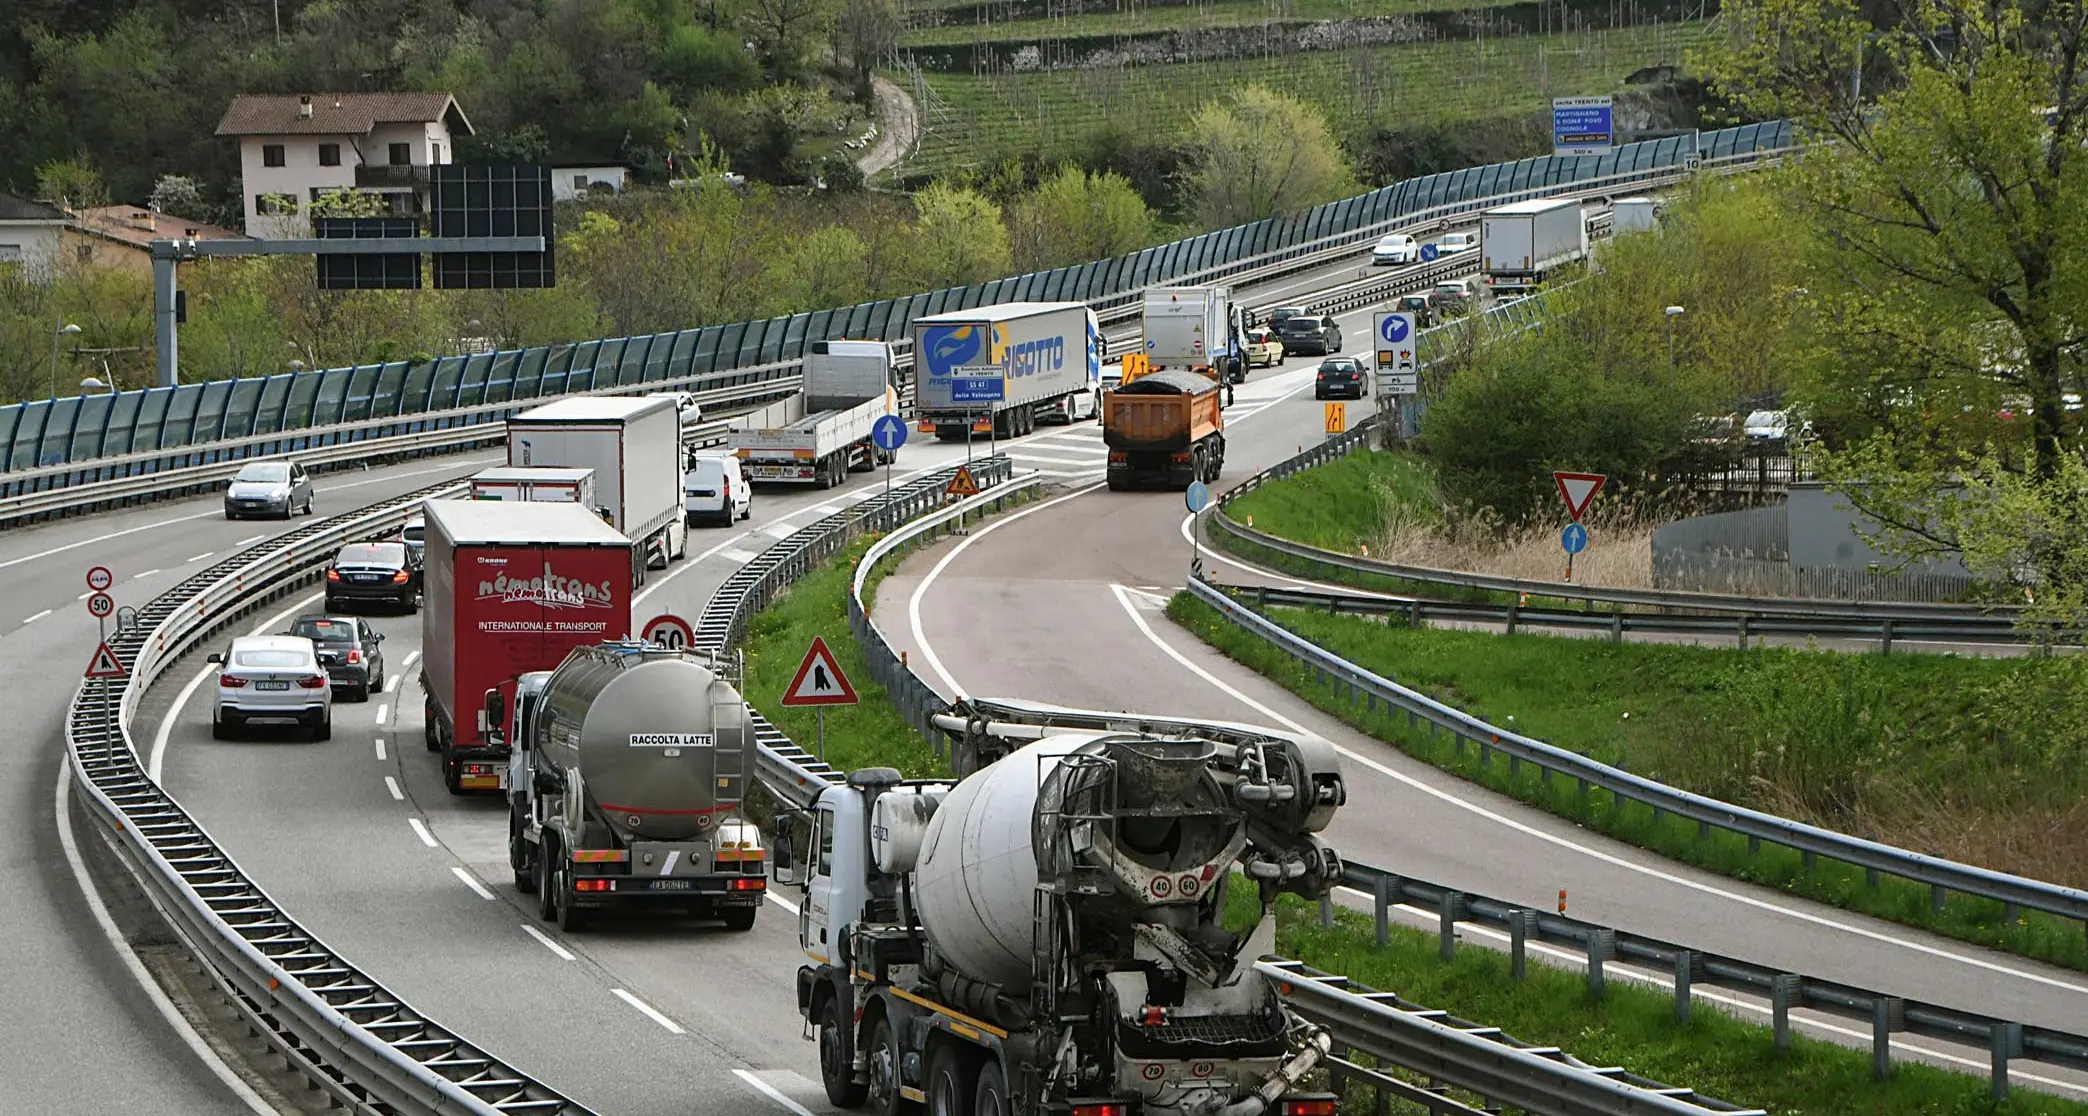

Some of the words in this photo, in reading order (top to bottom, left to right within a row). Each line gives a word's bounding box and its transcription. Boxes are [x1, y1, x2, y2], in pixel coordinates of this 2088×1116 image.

[1686, 160, 1699, 169] 10
[1002, 336, 1063, 380] RIGOTTO
[93, 599, 108, 611] 50
[478, 621, 552, 631] INTERNATIONALE
[554, 622, 607, 632] TRANSPORT
[654, 629, 684, 650] 50
[631, 735, 680, 745] RACCOLTA
[683, 735, 711, 745] LATTE
[873, 826, 888, 840] CFA
[1156, 881, 1167, 891] 40
[1183, 881, 1194, 890] 60
[1149, 1066, 1160, 1076] 70
[1198, 1063, 1209, 1073] 80
